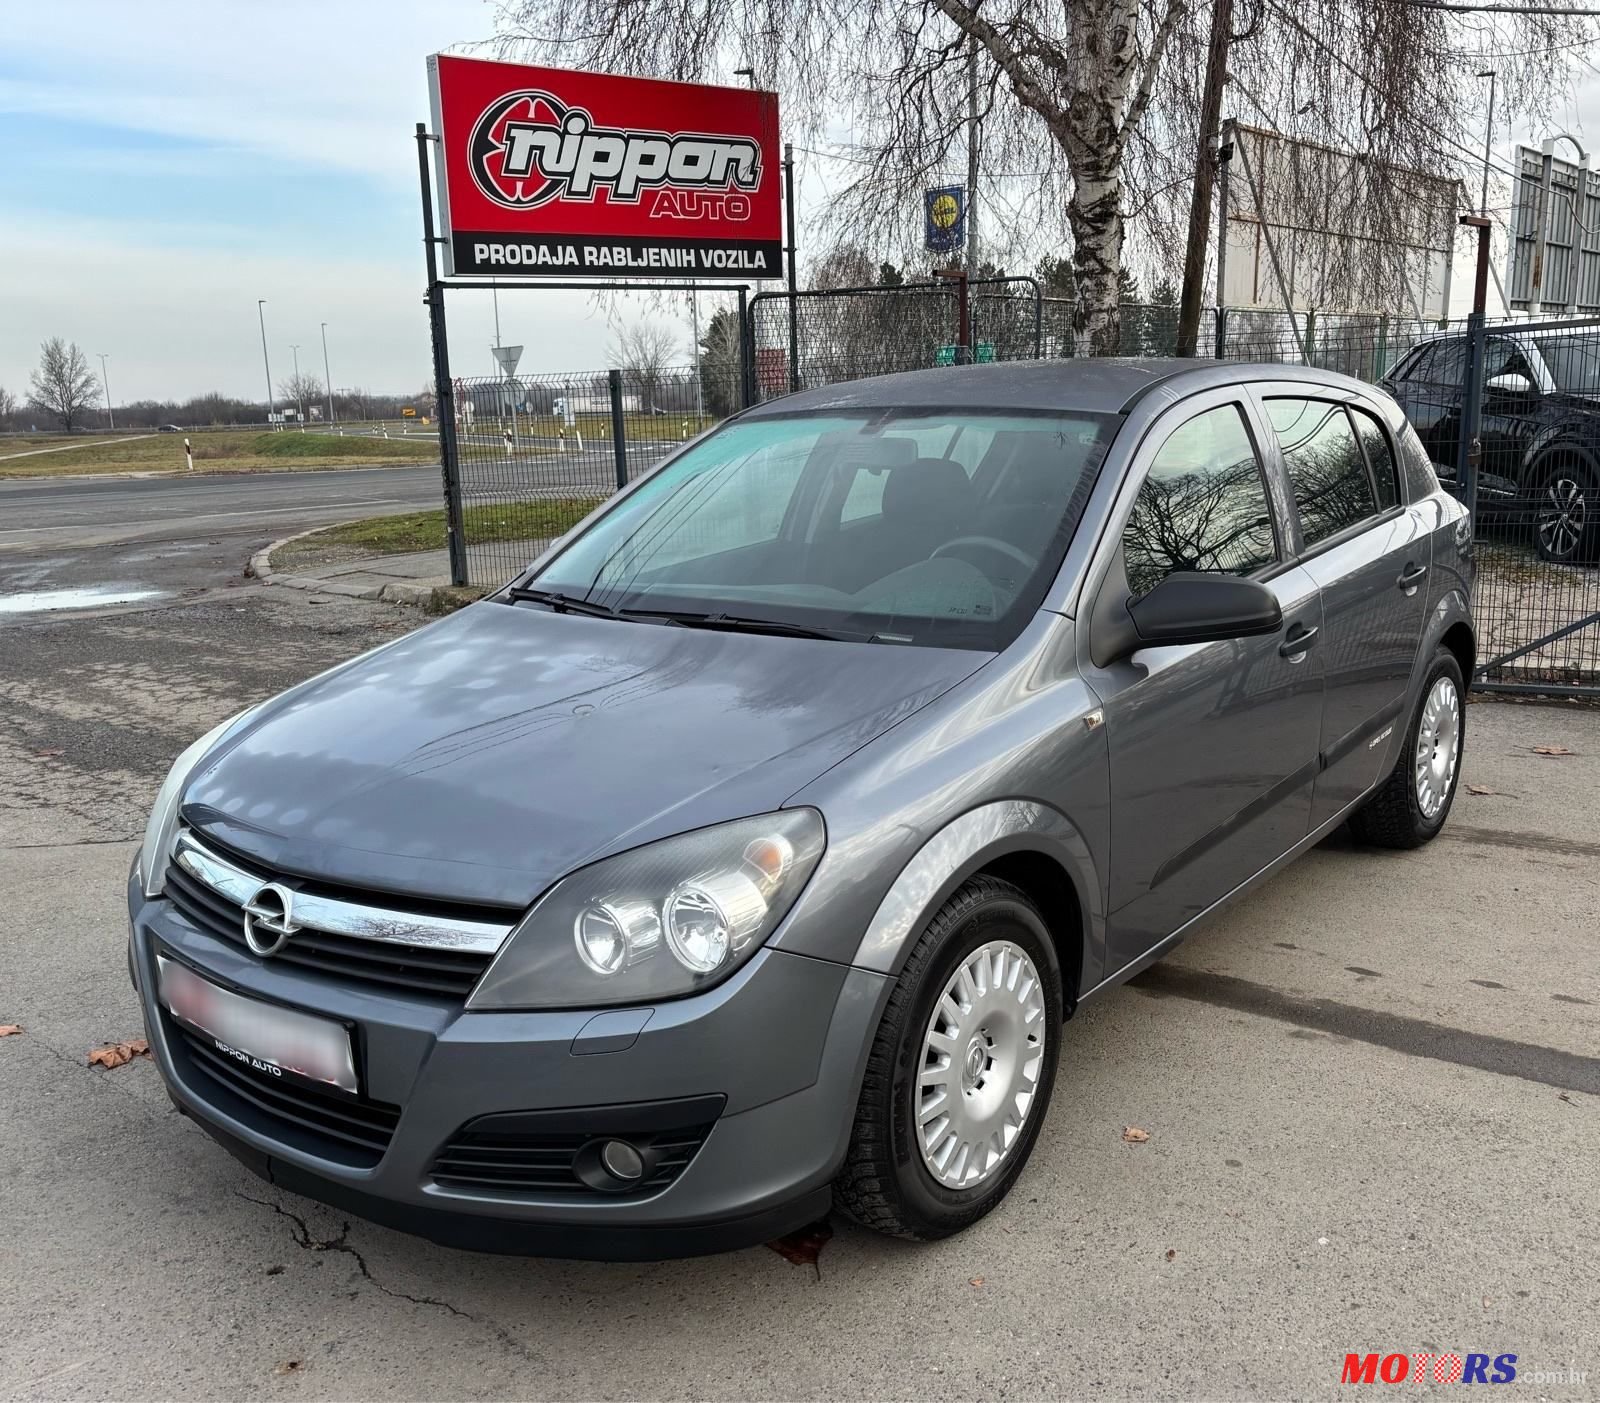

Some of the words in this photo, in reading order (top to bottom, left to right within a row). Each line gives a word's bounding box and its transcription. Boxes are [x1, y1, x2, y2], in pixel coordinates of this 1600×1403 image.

[503, 113, 761, 198] nippon
[650, 191, 751, 221] AUTO
[474, 243, 580, 266] PRODAJA
[583, 245, 697, 267] RABLJENIH
[700, 248, 767, 269] VOZILA
[214, 1039, 250, 1065] NIPPON
[251, 1058, 282, 1077] AUTO
